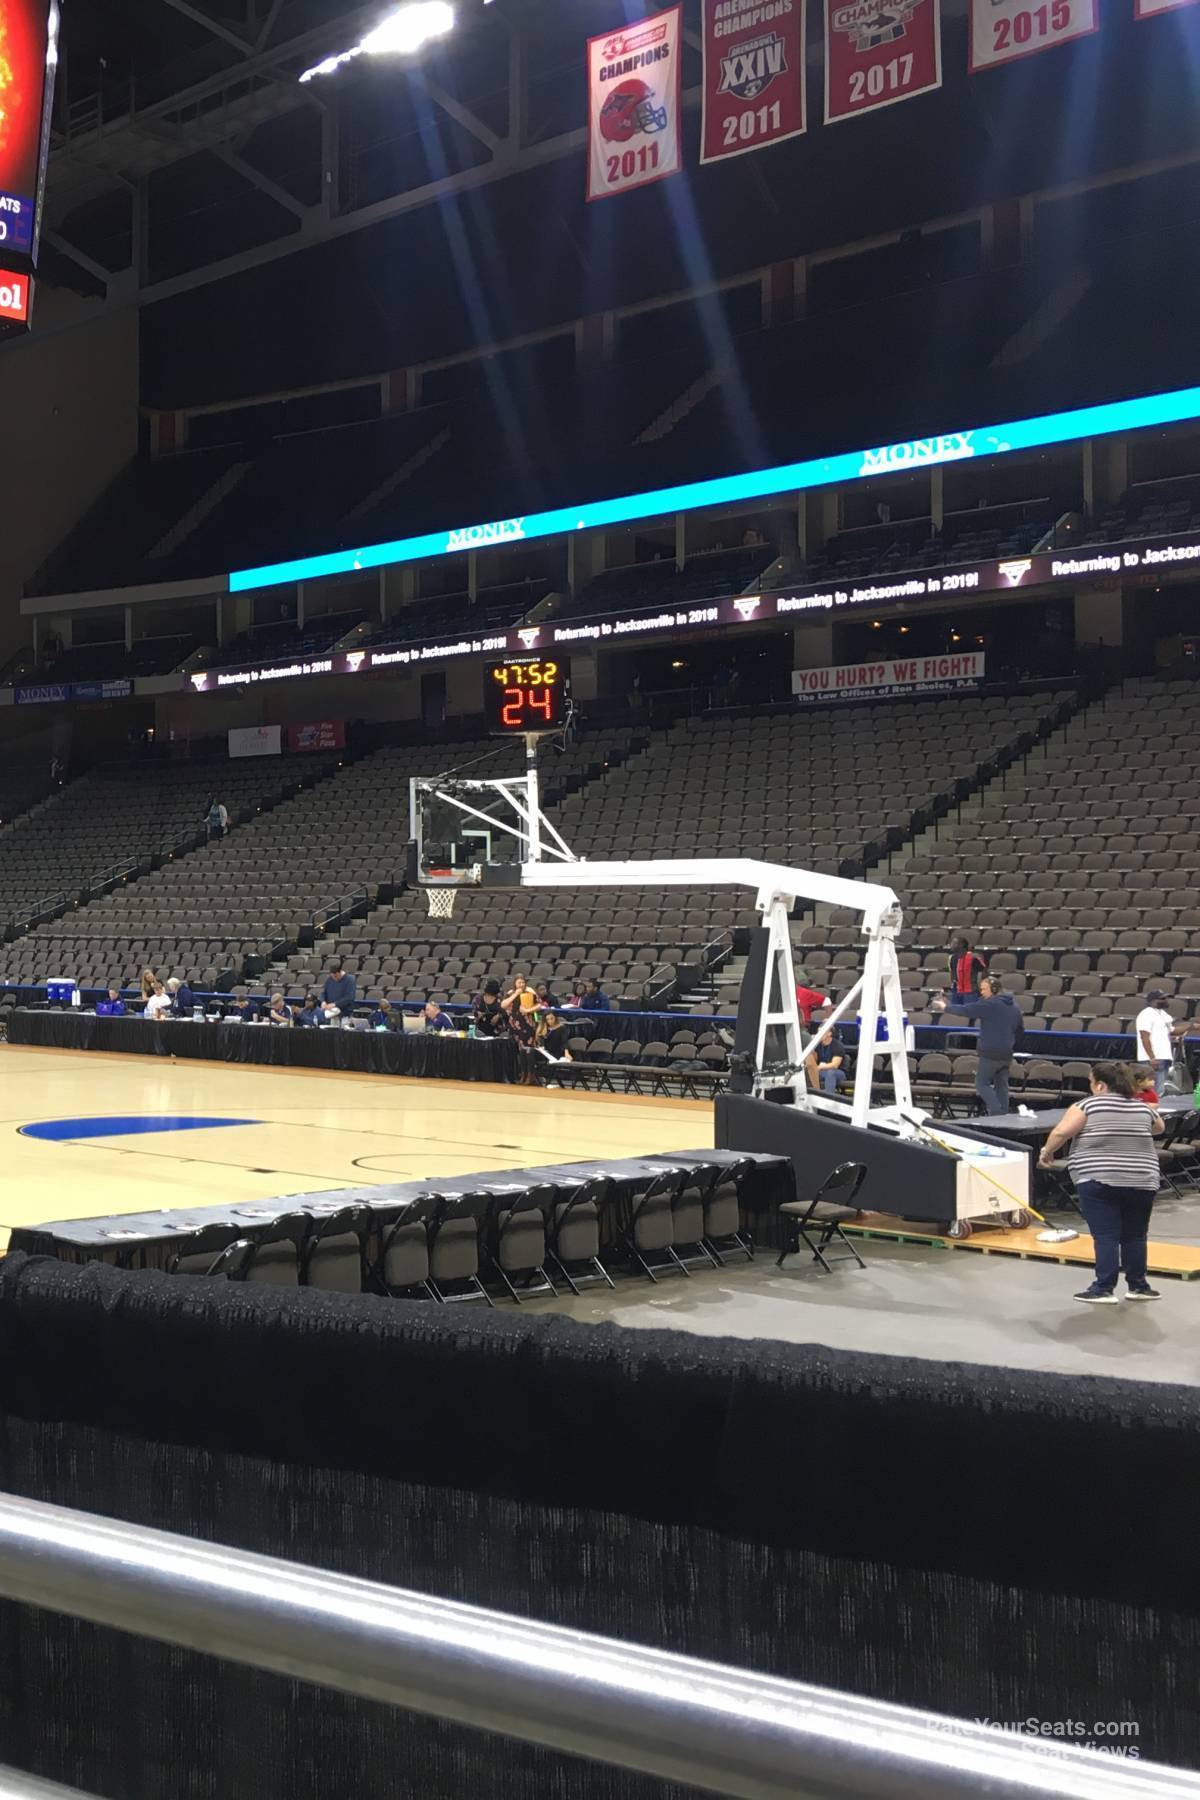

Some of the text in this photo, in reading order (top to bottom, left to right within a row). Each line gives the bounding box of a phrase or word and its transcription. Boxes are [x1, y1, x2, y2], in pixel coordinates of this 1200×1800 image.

[714, 0, 793, 38] CHAMPIONS
[993, 0, 1070, 51] 2015
[599, 43, 670, 82] CHAMPIONS
[721, 42, 782, 90] XXIV
[848, 53, 913, 103] 2017
[723, 101, 780, 146] 2011
[607, 141, 658, 183] 2011
[863, 431, 973, 466] MONEY
[449, 517, 524, 543] MONEY
[1052, 543, 1200, 576] Returning to Jackson
[777, 572, 979, 611] Returning to Jacksonville in 2019!
[554, 607, 718, 641] Returning to Jacksonville in 2019!
[371, 636, 506, 665] Returning to Jacksonville in 2019!
[494, 662, 557, 685] 47:52
[799, 655, 977, 691] YOU HURT? WE FIGHT!
[20, 687, 64, 698] MONEY
[503, 688, 551, 725] 24
[799, 694, 815, 702] The
[818, 692, 837, 700] Law
[840, 688, 875, 698] Offices
[878, 686, 890, 695] of
